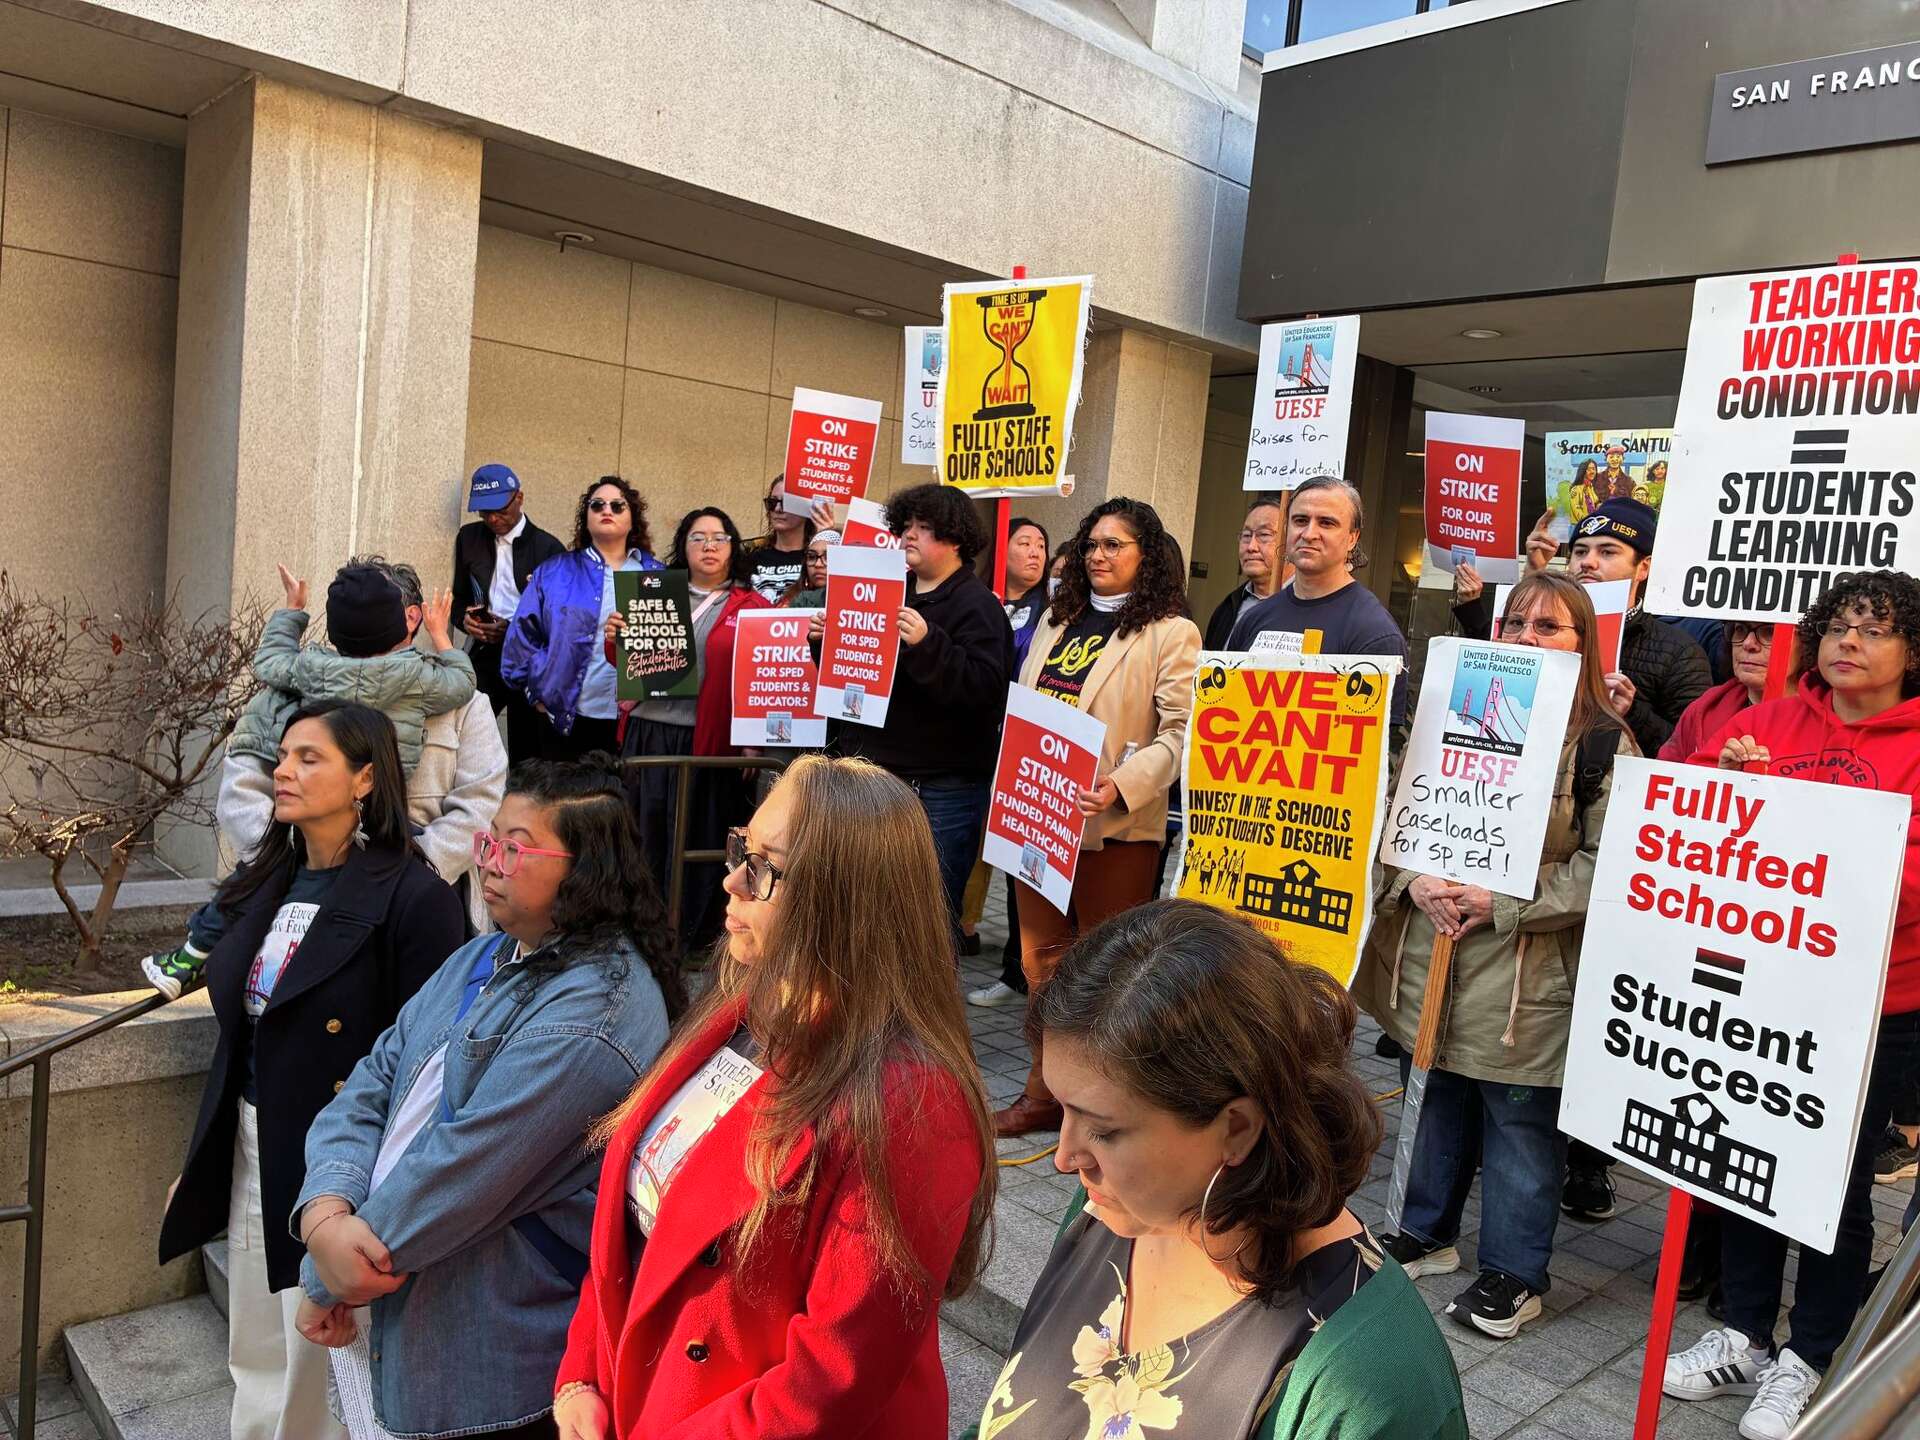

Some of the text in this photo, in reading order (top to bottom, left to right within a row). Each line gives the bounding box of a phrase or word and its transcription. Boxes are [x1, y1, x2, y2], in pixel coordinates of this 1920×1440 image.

[1731, 79, 1791, 109] SAN
[992, 292, 1030, 306] TIME IS UP!
[1749, 268, 1920, 324] TEACHER
[998, 306, 1025, 320] WE
[989, 320, 1031, 338] CAN'T
[1742, 317, 1920, 372] WORKING
[922, 391, 937, 408] U
[987, 384, 1028, 404] WAIT
[1275, 397, 1327, 420] UESF
[821, 420, 848, 437] ON
[952, 415, 1051, 452] FULLY STAFF
[1251, 424, 1329, 447] Raises for
[804, 438, 858, 460] STRIKE
[1557, 437, 1672, 455] Somos SANTU
[807, 456, 850, 471] FOR SPED
[947, 445, 1055, 482] OUR SCHOOLS
[1455, 453, 1484, 474] ON
[800, 467, 854, 484] STUDENTS &
[798, 479, 851, 495] EDUCATORS
[1439, 478, 1499, 503] STRIKE
[1718, 471, 1917, 517] STUDENTS
[1442, 506, 1493, 526] FOR OUR
[1438, 522, 1495, 543] STUDENTS
[1611, 521, 1638, 538] UESF
[874, 532, 902, 550] ON
[1707, 519, 1899, 568] LEARNING
[757, 565, 776, 574] THE
[853, 582, 877, 602] ON
[1682, 566, 1854, 614] CONDITI
[628, 599, 676, 611] SAFE &
[628, 612, 679, 624] STABLE
[838, 609, 887, 633] STRIKE
[620, 625, 687, 637] SCHOOLS
[770, 621, 799, 638] ON
[624, 637, 688, 651] FOR OUR
[841, 633, 880, 649] FOR SPED
[752, 645, 811, 662] STRIKE
[835, 649, 883, 666] STUDENTS &
[1463, 649, 1537, 667] UNITED EDUCATORS
[756, 667, 804, 678] FOR SPED
[832, 664, 880, 682] EDUCATORS
[1472, 660, 1487, 671] SAN
[1488, 662, 1532, 676] FRANCISCO
[750, 682, 811, 692] STUDENTS &
[1241, 671, 1337, 711] WE
[748, 696, 808, 707] EDUCATORS
[1197, 707, 1378, 755] CAN'T
[1040, 734, 1069, 764] ON
[1200, 744, 1359, 795] WAIT
[1441, 748, 1518, 788] UESF
[1018, 756, 1078, 803] STRIKE
[1014, 778, 1073, 820] FOR FULLY
[1411, 774, 1524, 812] Smaller
[1188, 789, 1352, 833] INVEST IN THE SCHOOLS
[1643, 774, 1765, 838] Fully
[996, 790, 1043, 823] FUNDED
[1044, 815, 1080, 849] FAMILY
[1000, 813, 1070, 865] HEALTHCARE
[1189, 814, 1354, 861] OUR STUDENTS DESERVE
[1390, 830, 1419, 854] for
[1635, 823, 1829, 898] Staffed
[1626, 873, 1838, 959] Schools
[1610, 972, 1818, 1075] Student
[1603, 1017, 1826, 1131] Success
